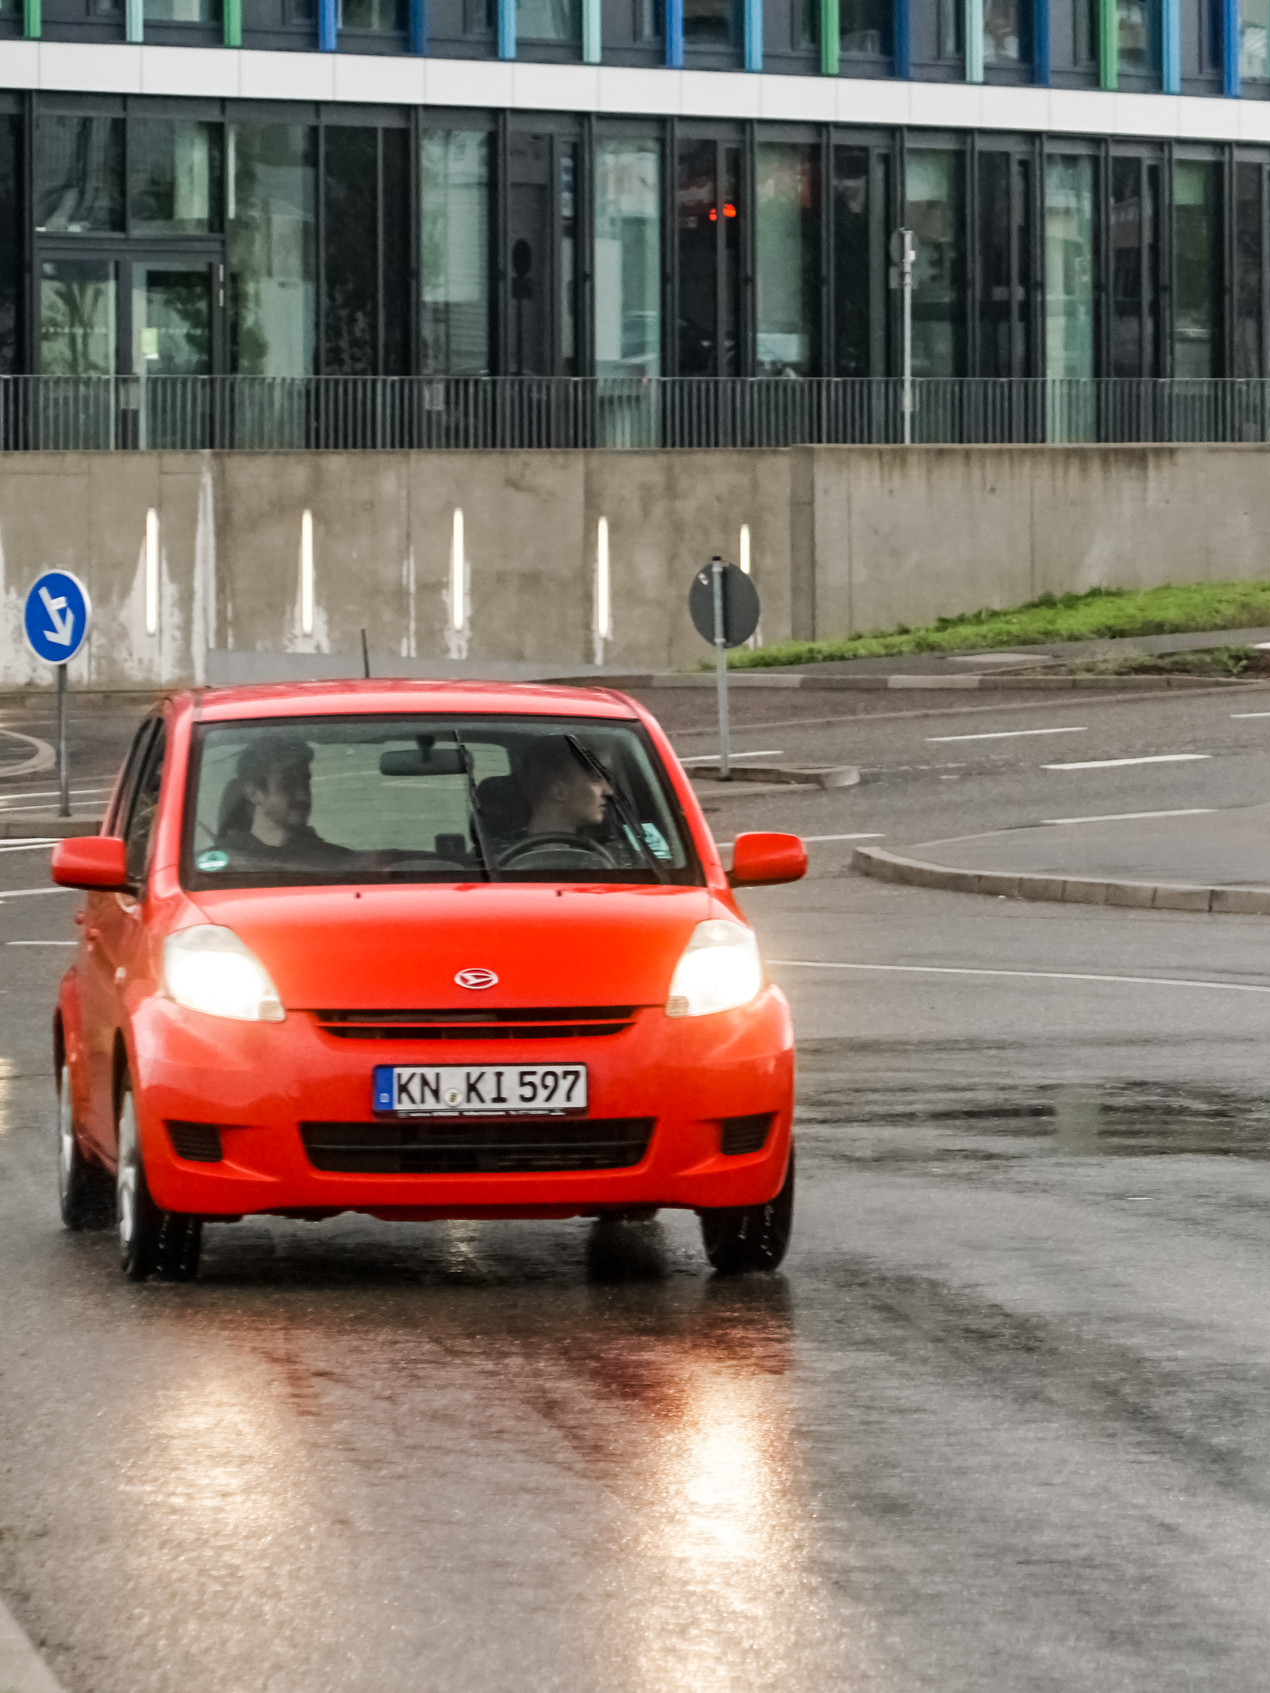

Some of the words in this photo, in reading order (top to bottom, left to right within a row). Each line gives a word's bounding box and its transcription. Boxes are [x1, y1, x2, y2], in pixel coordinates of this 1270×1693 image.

[397, 1072, 440, 1105] KN
[466, 1071, 508, 1104] KI
[518, 1069, 581, 1103] 597
